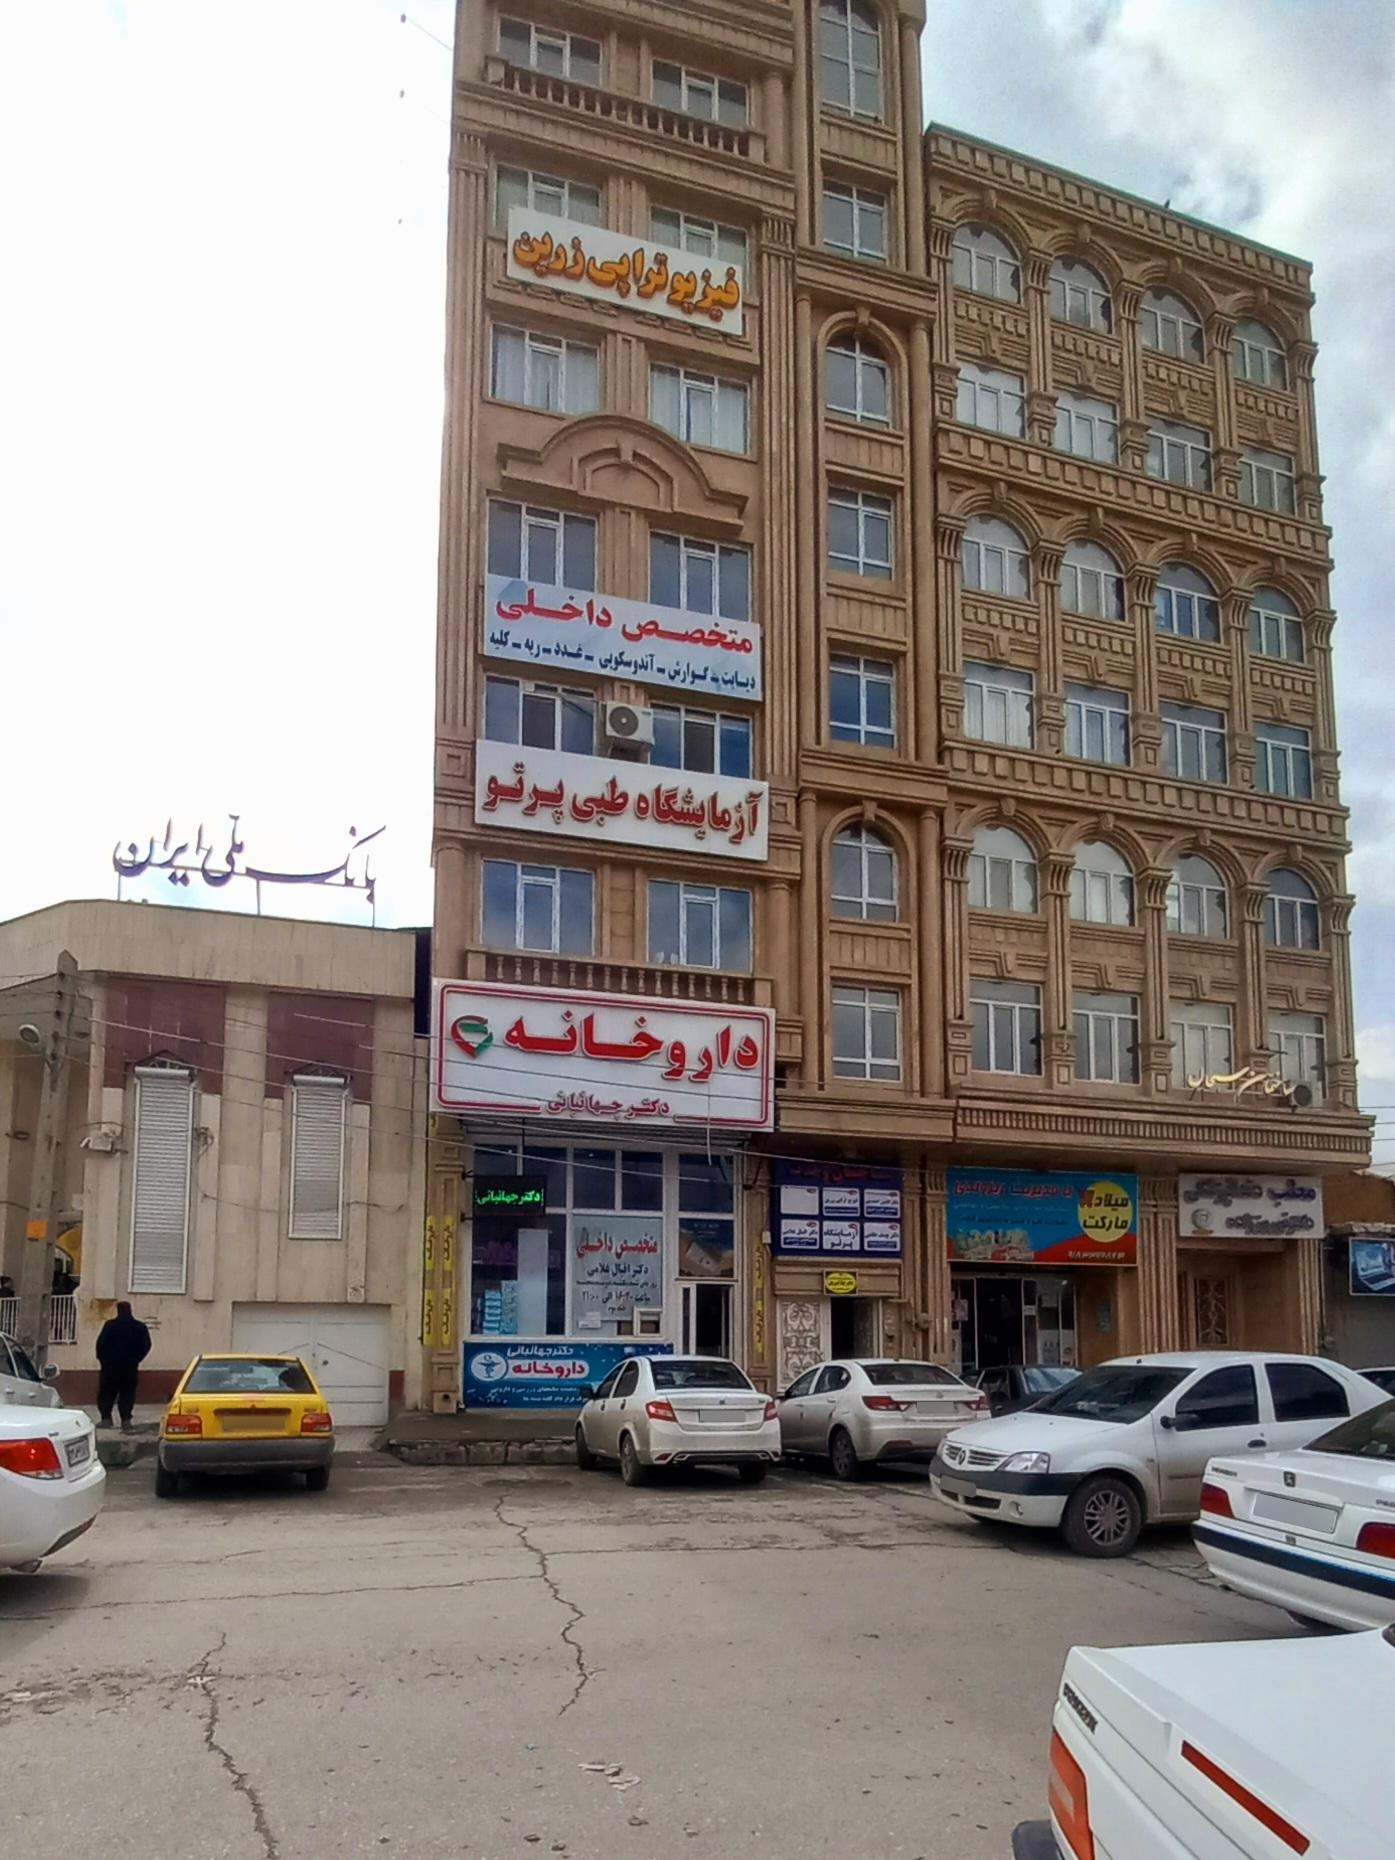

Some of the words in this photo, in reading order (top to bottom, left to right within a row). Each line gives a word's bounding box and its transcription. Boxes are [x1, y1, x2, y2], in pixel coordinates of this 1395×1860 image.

[512, 231, 585, 278] زرین
[587, 247, 740, 322] فیزیوتراپی
[496, 588, 613, 628] داخلی
[489, 629, 510, 650] کلیه
[621, 620, 753, 654] متخصص
[668, 660, 709, 684] گوارش
[721, 669, 756, 692] دیابت
[482, 761, 565, 825] پرتو
[570, 775, 630, 826] طبی
[632, 783, 764, 844] آزمایشگاه
[112, 817, 203, 886] ایران
[201, 814, 245, 888] ملی
[246, 825, 387, 904] بانک
[502, 1010, 760, 1082] داروخانه
[547, 1091, 623, 1122] جهانبانی
[626, 1098, 671, 1119] دکتر
[1094, 1192, 1129, 1211] میلاد
[1082, 1215, 1128, 1231] مارکت
[511, 1362, 586, 1380] داروخانه
